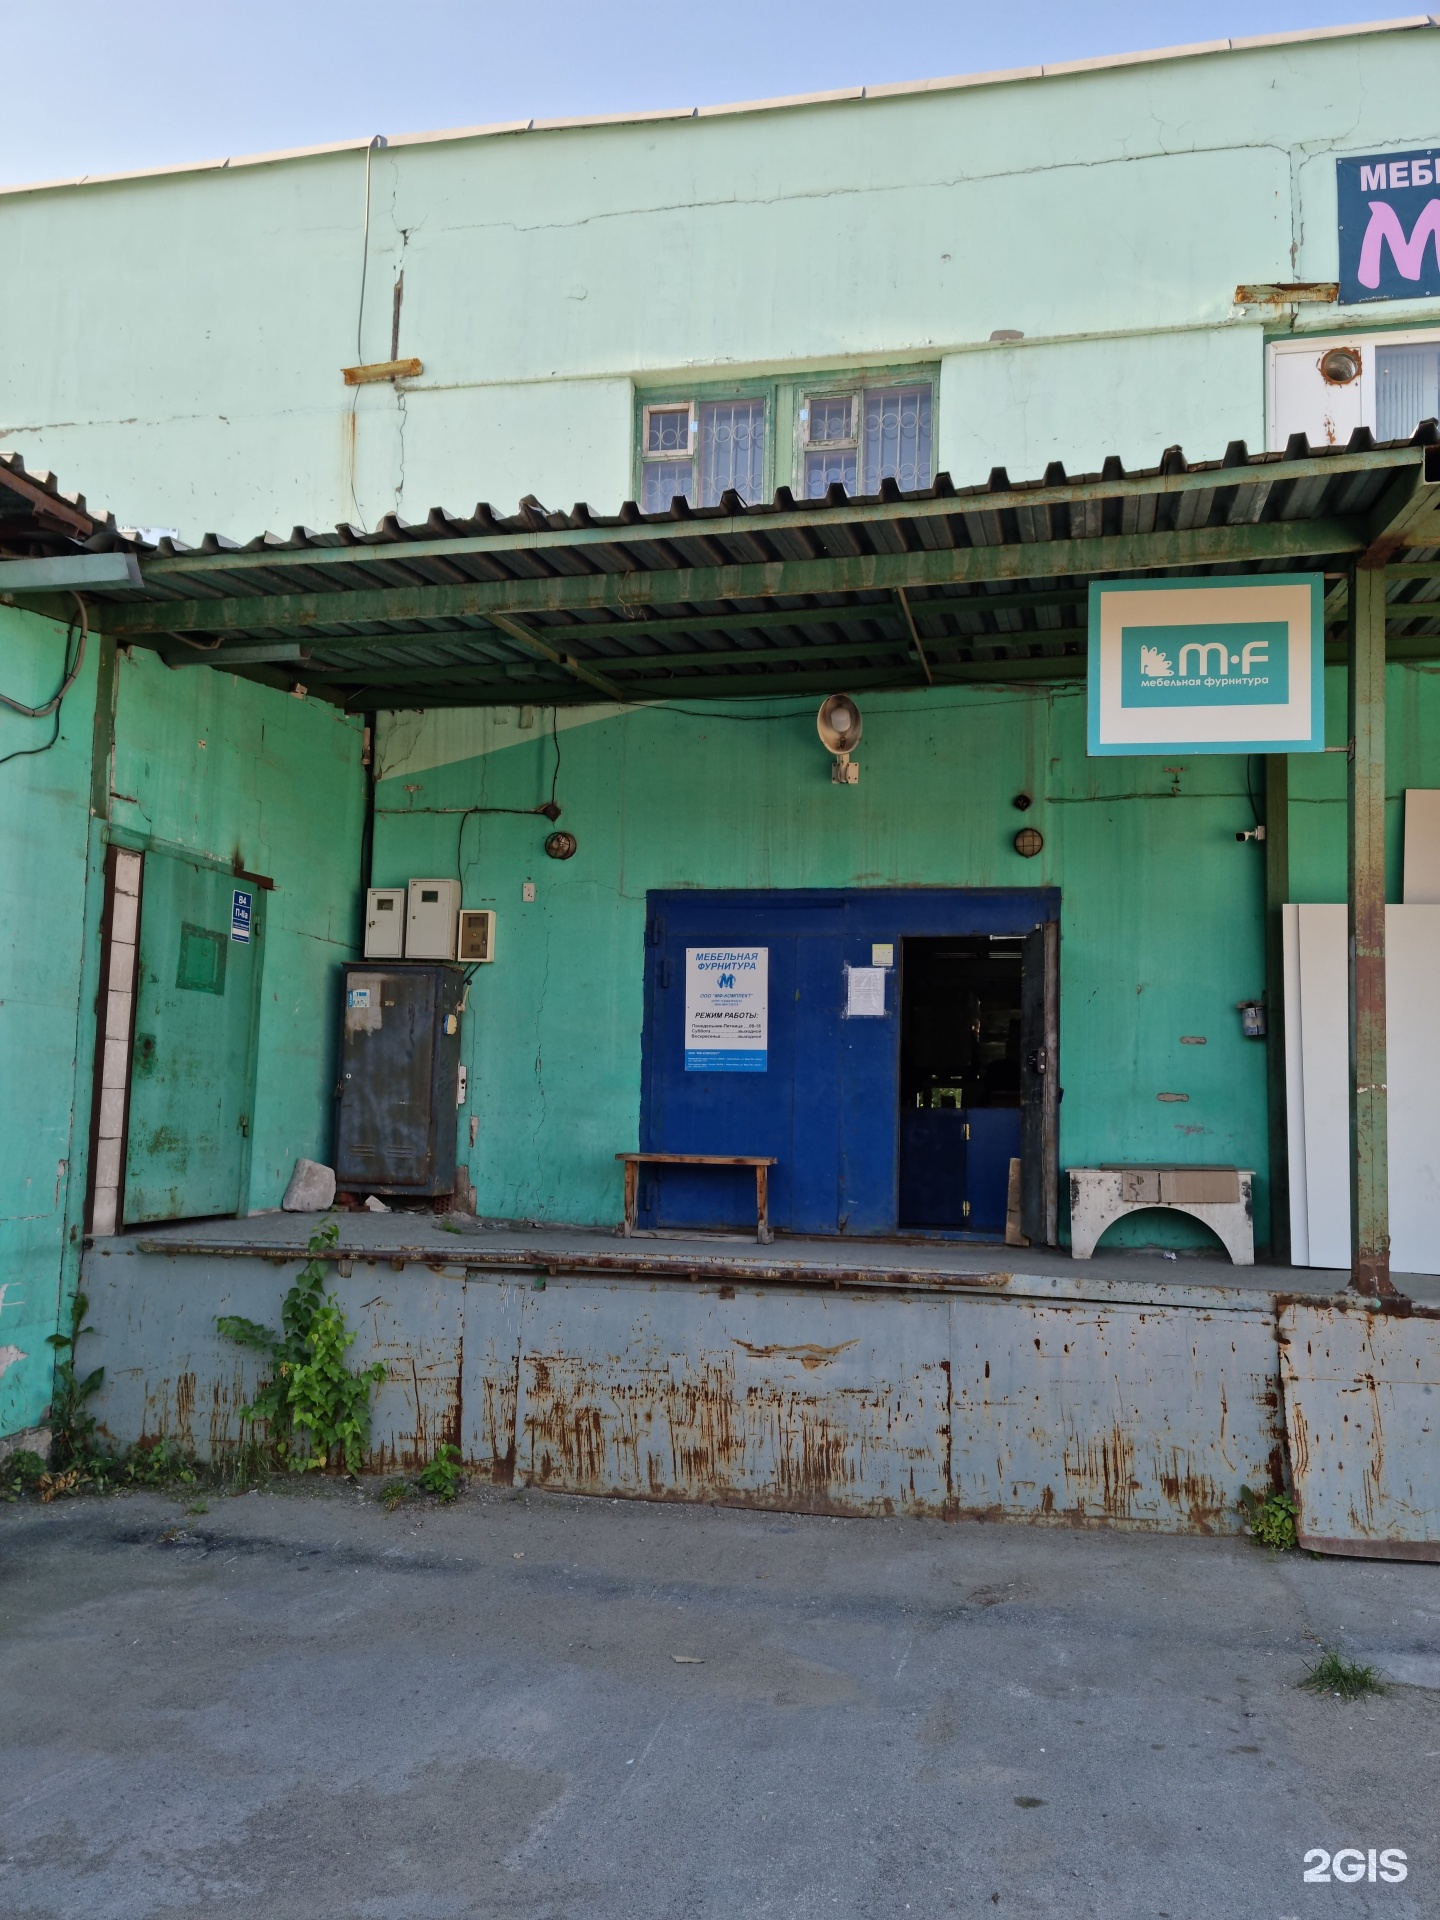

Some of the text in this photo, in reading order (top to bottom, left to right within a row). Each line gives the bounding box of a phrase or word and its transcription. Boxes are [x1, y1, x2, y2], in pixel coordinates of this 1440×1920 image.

[1140, 675, 1269, 688] мебельная фурнитура
[695, 952, 759, 961] МЕБЕЛЬНАЯ
[697, 962, 756, 970] ФУРНИТУРА
